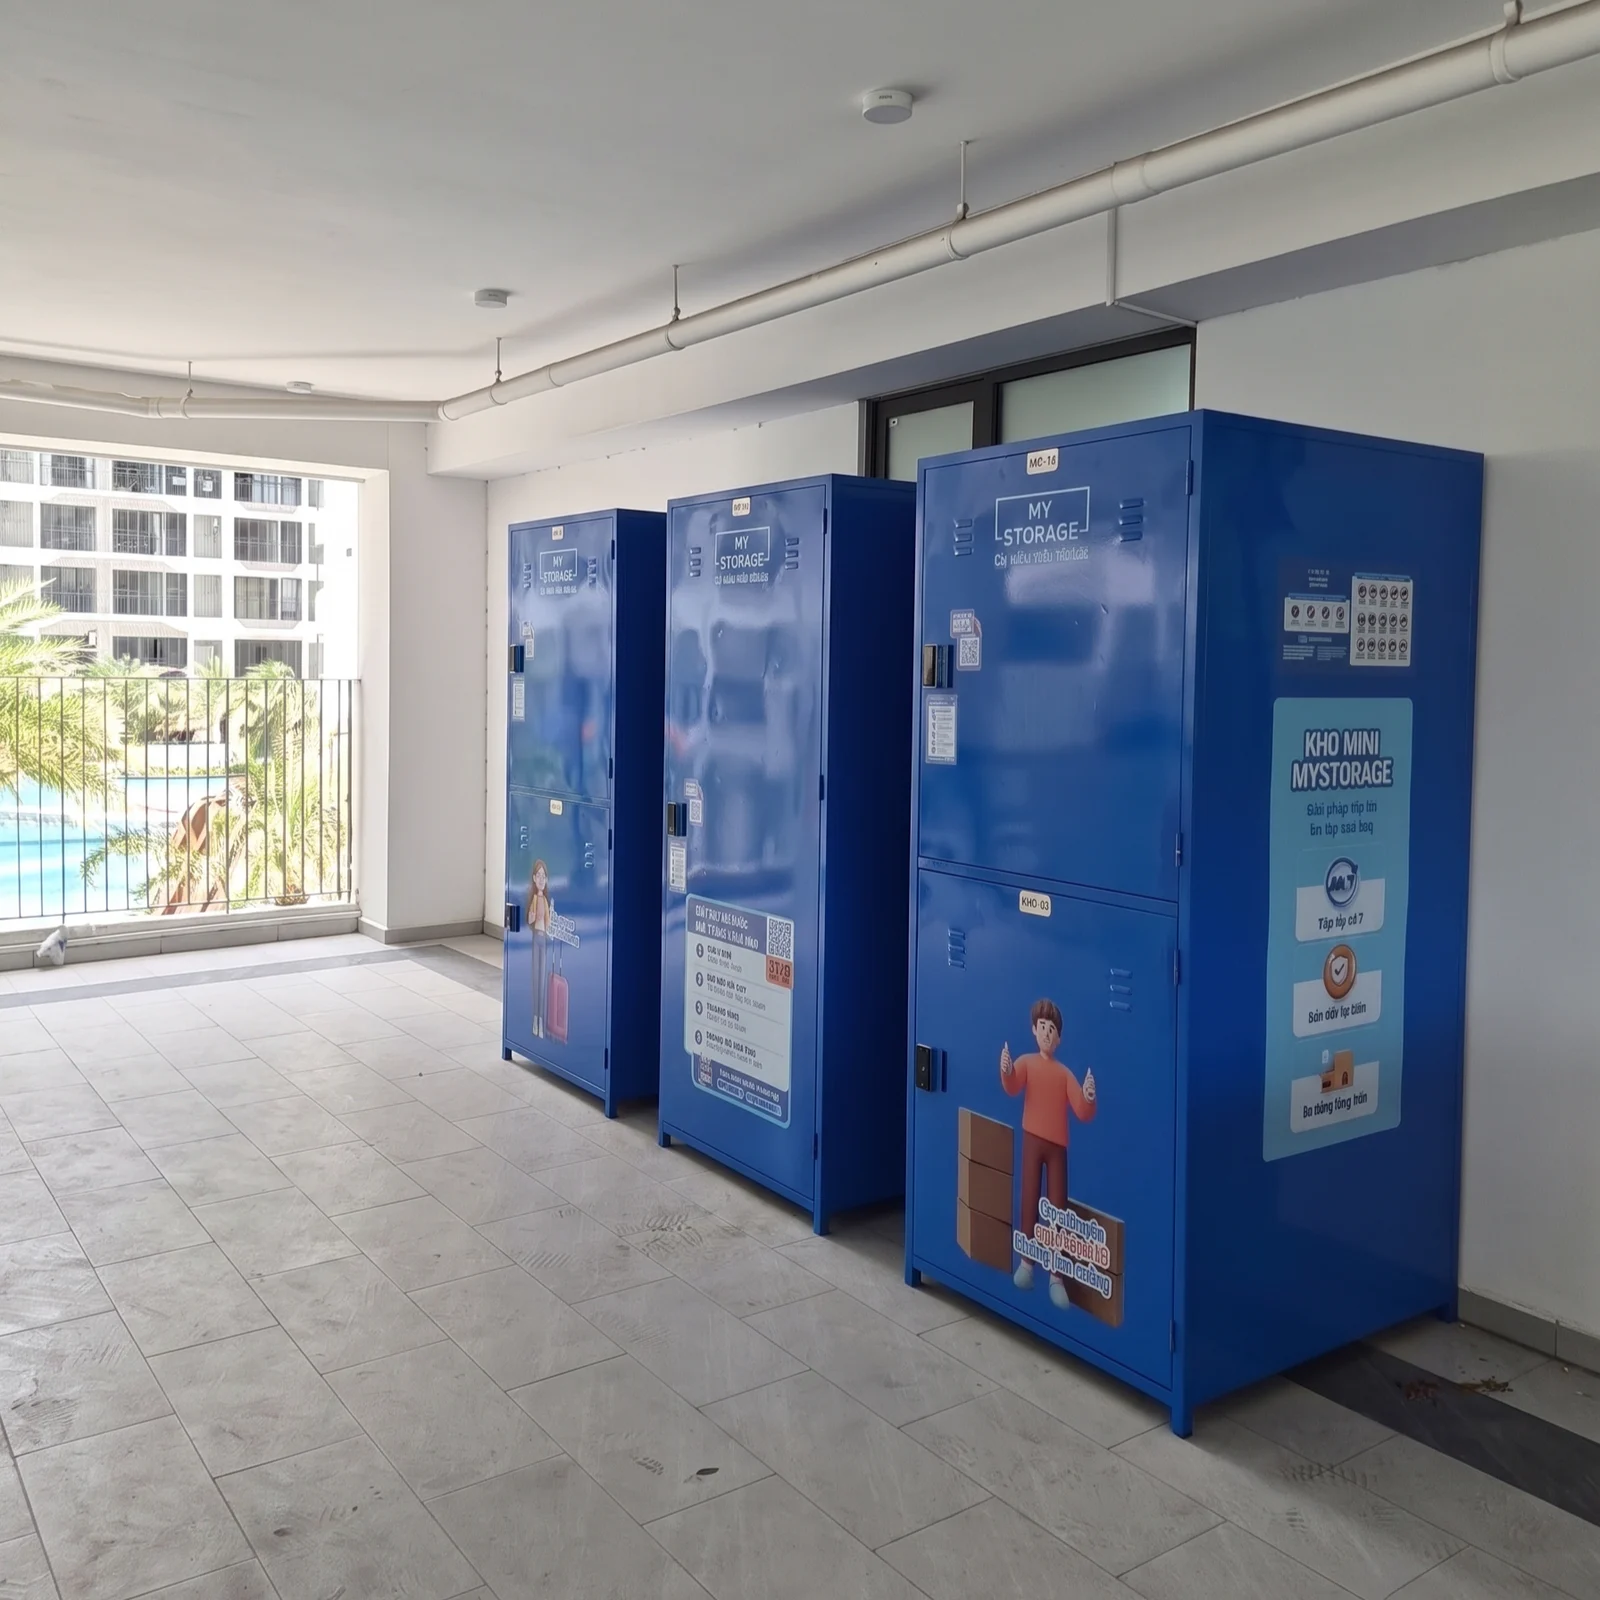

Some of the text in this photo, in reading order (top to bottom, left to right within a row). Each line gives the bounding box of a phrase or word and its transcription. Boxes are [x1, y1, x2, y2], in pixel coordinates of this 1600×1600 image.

[1029, 455, 1056, 468] MC-16
[1028, 500, 1053, 520] MY
[734, 535, 749, 550] MY
[1003, 521, 1079, 546] STORAGE
[552, 555, 563, 568] MY
[720, 552, 764, 570] STORAGE
[543, 569, 573, 583] STORAGE
[1304, 730, 1379, 757] KHO MINI
[1292, 760, 1392, 789] MYSTORAGE
